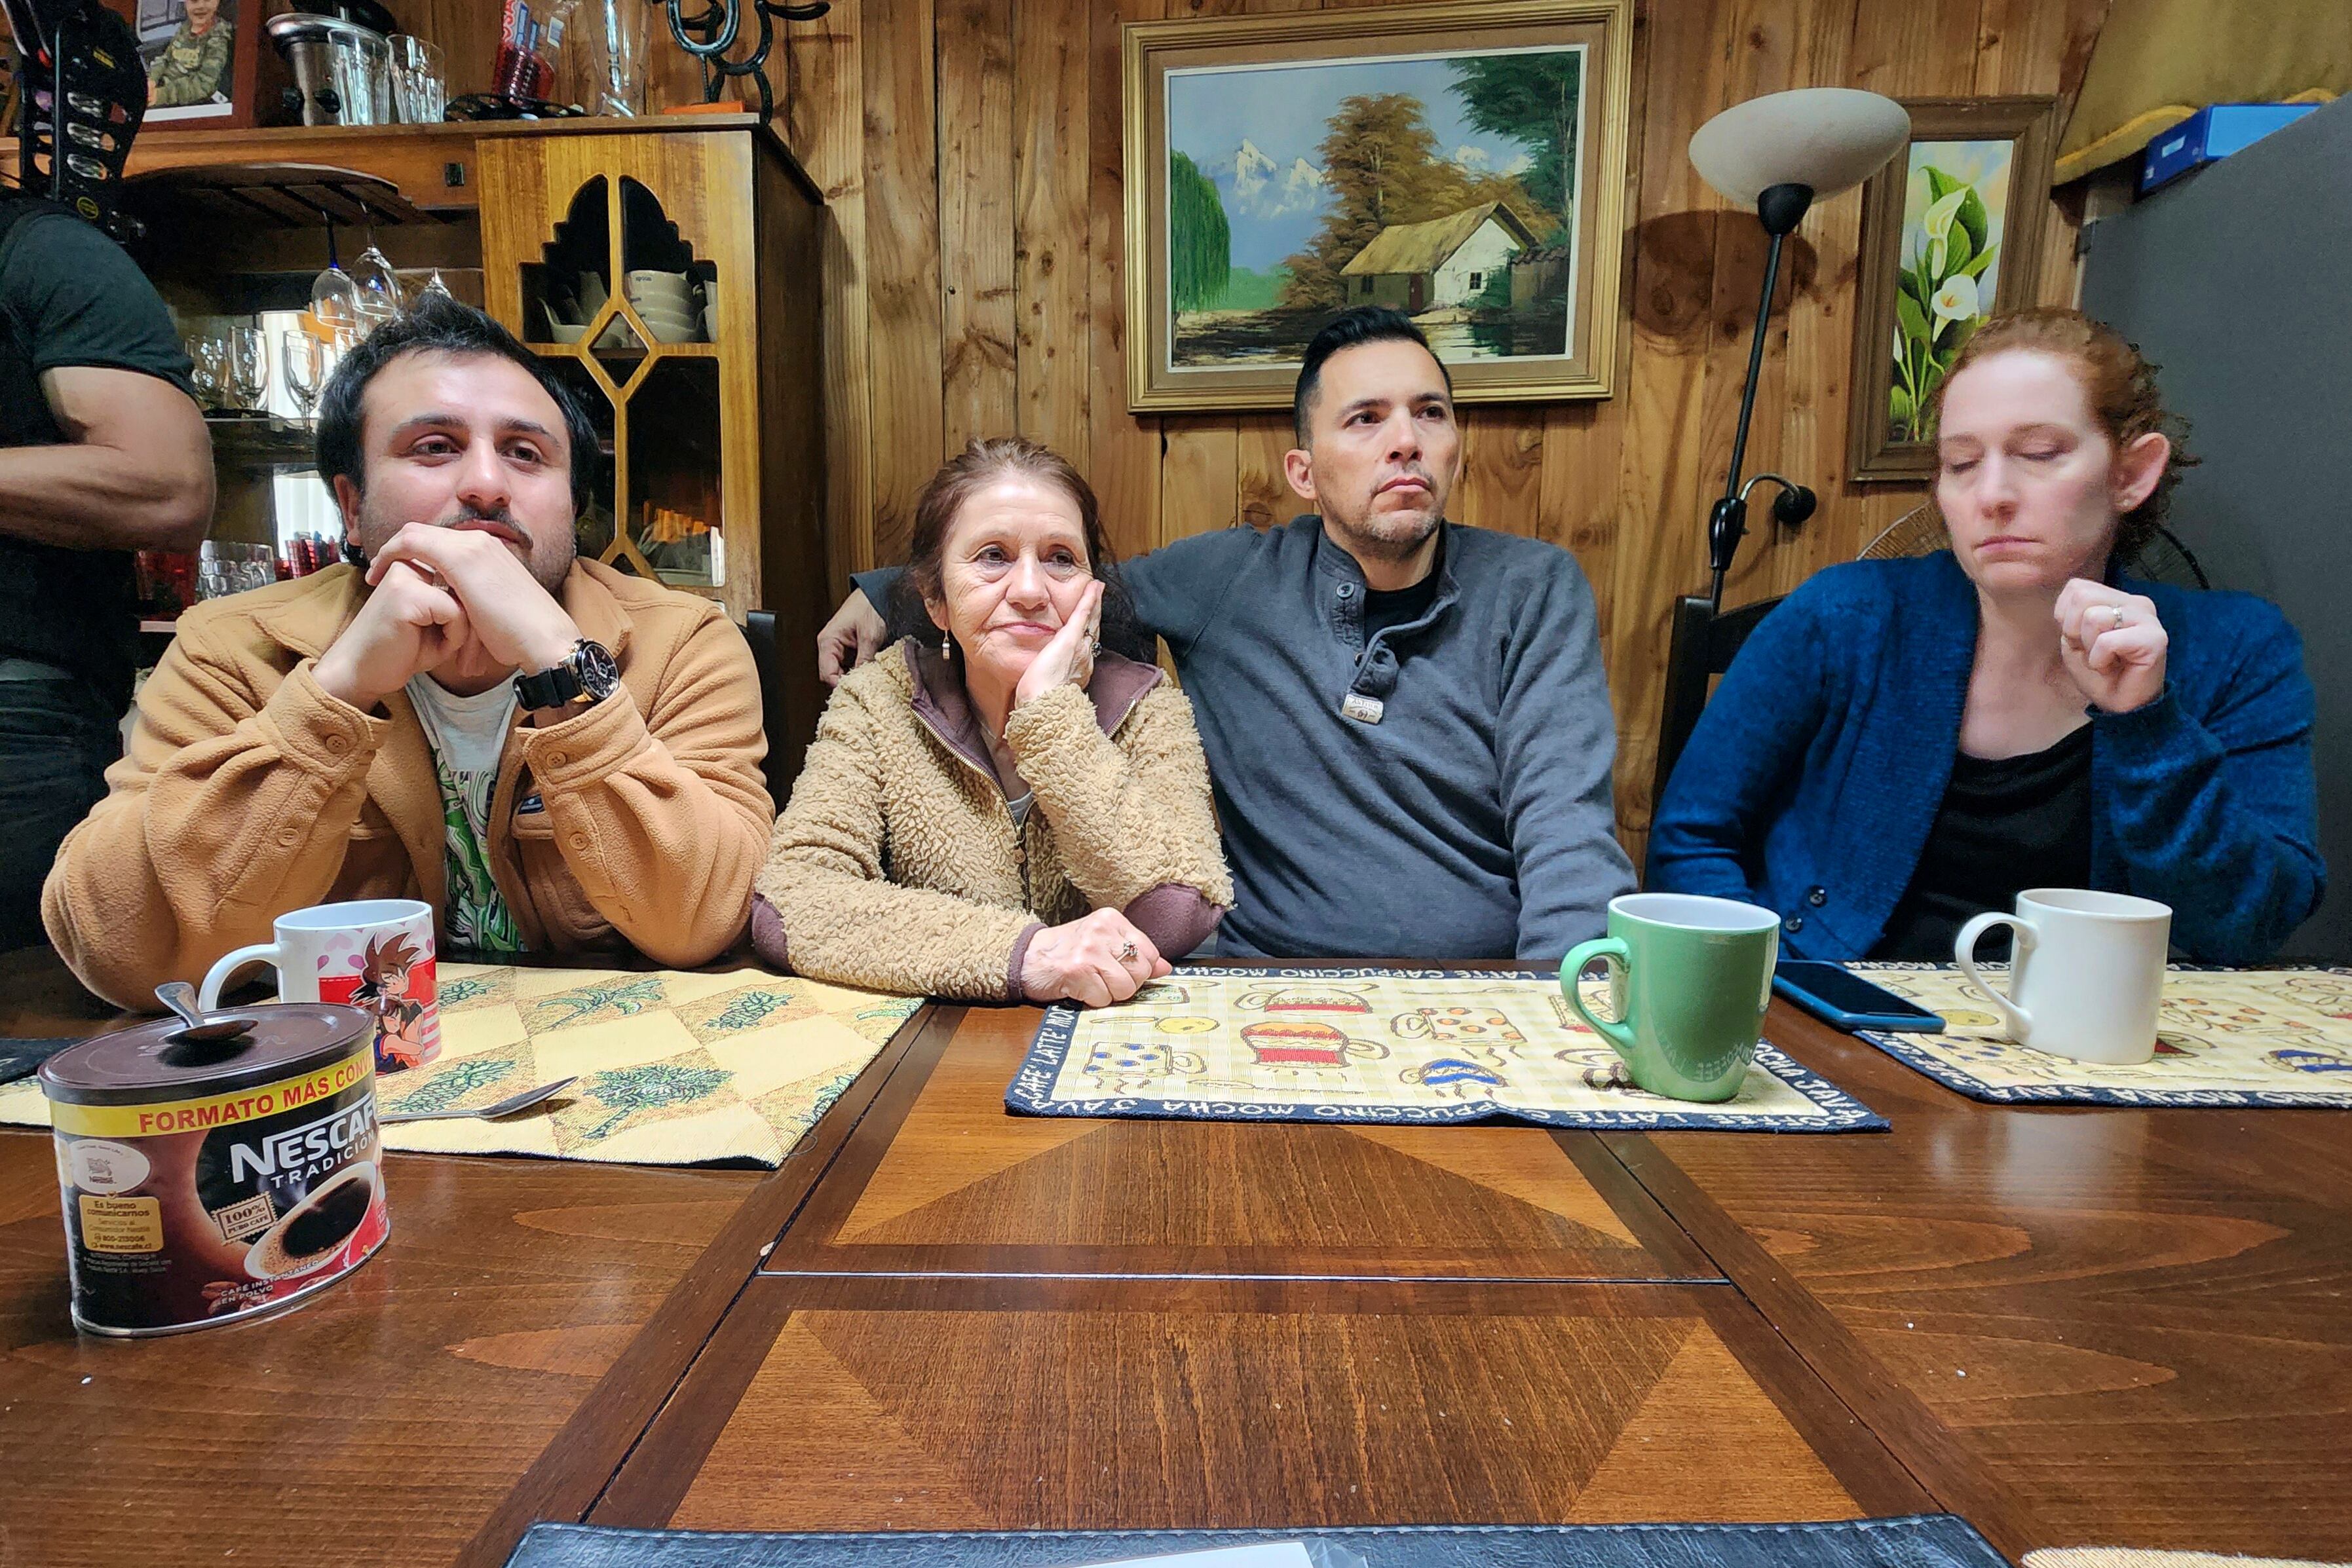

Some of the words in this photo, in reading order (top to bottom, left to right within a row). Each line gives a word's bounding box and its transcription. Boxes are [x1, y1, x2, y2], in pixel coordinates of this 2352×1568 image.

[1175, 966, 1268, 977] MOCHA
[1280, 968, 1445, 979] CAPPUCCINO
[1045, 1005, 1075, 1028] MOC
[139, 1094, 274, 1133] FORMATO
[282, 1076, 330, 1110] MÁS
[335, 1053, 371, 1089] CONV
[2108, 1088, 2248, 1104] MOCHA
[1031, 1098, 1138, 1113] JAVA
[1162, 1100, 1296, 1115] MOCHA
[1566, 1110, 1688, 1125] LATTE
[230, 1091, 377, 1184] NESCAF
[94, 1200, 104, 1209] Es
[107, 1201, 136, 1209] bueno
[224, 1202, 265, 1225] 100%
[227, 1223, 250, 1235] PURO
[220, 1281, 250, 1297] CAFÉ
[221, 1295, 237, 1305] EN
[238, 1284, 274, 1300] POLVO
